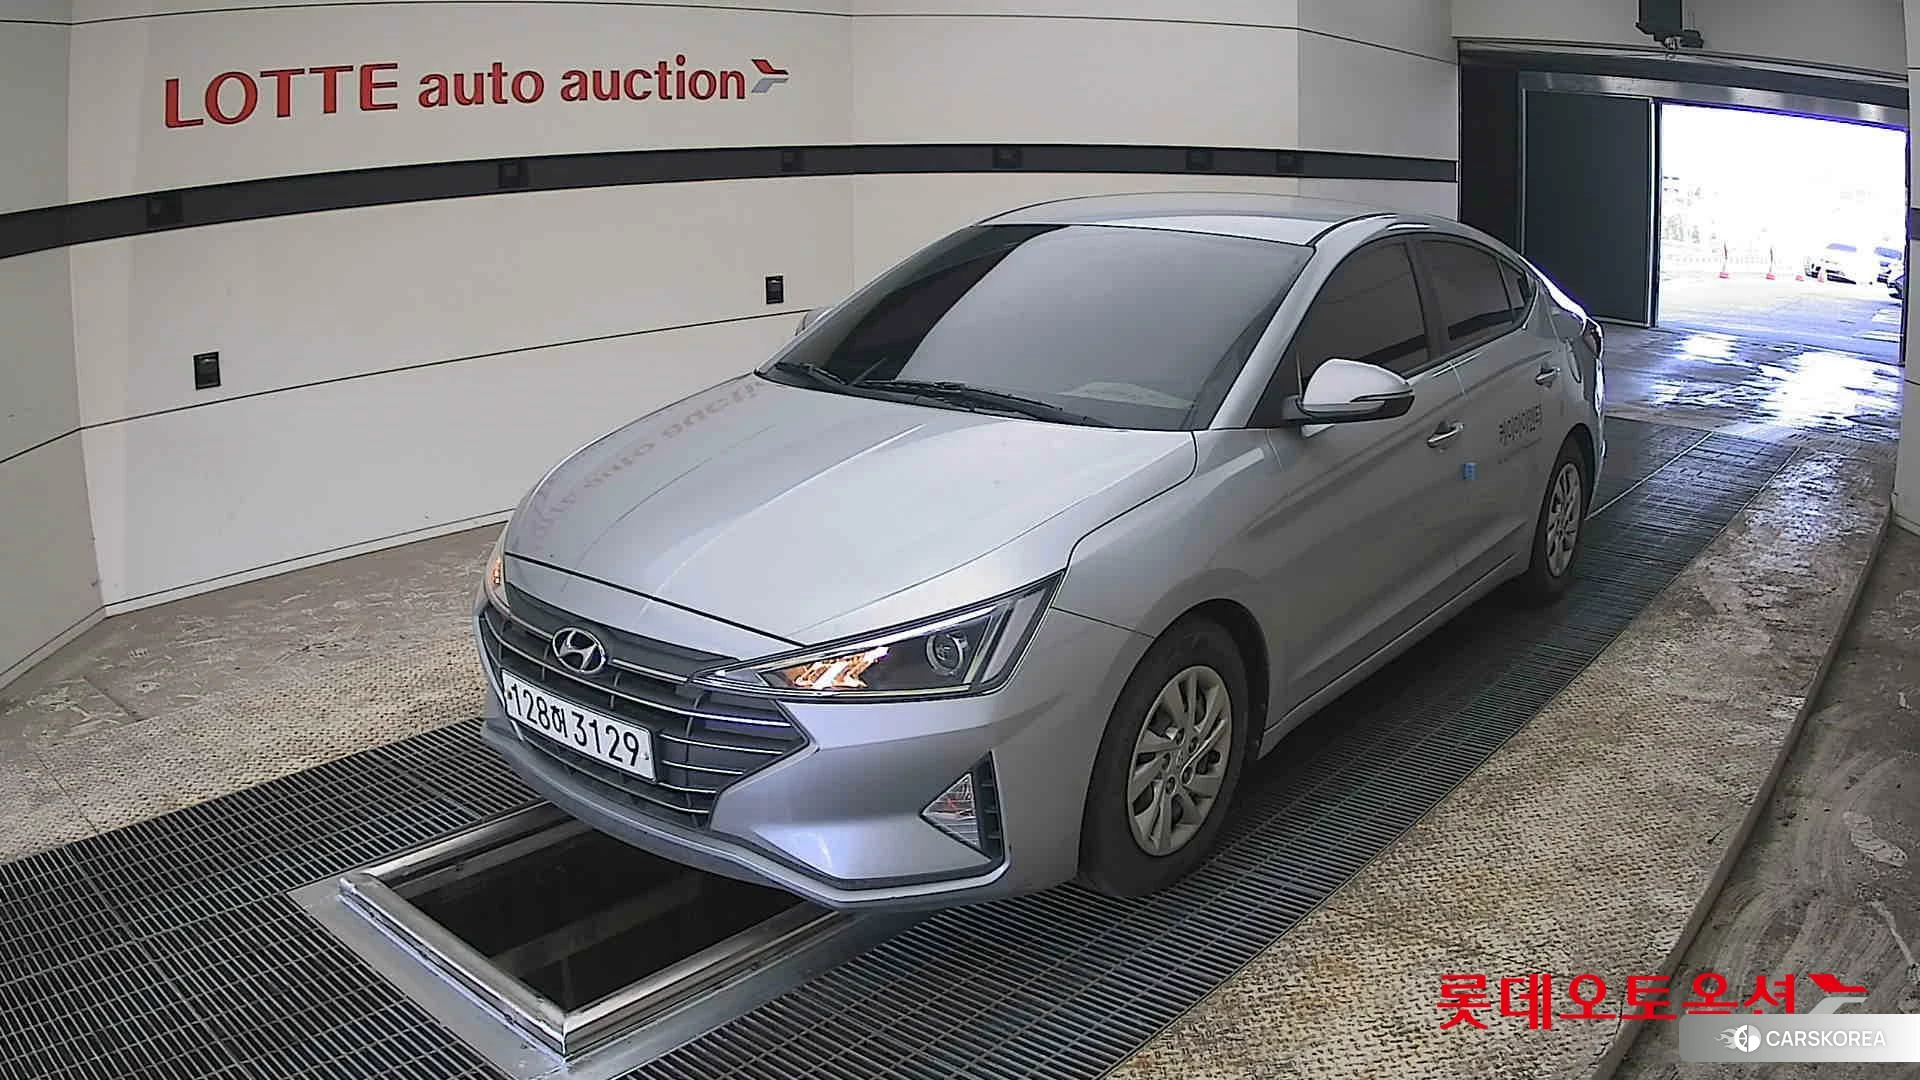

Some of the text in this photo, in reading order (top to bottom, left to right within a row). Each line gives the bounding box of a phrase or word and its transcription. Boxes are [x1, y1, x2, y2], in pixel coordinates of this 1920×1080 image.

[165, 54, 746, 128] LOTTE auto auction
